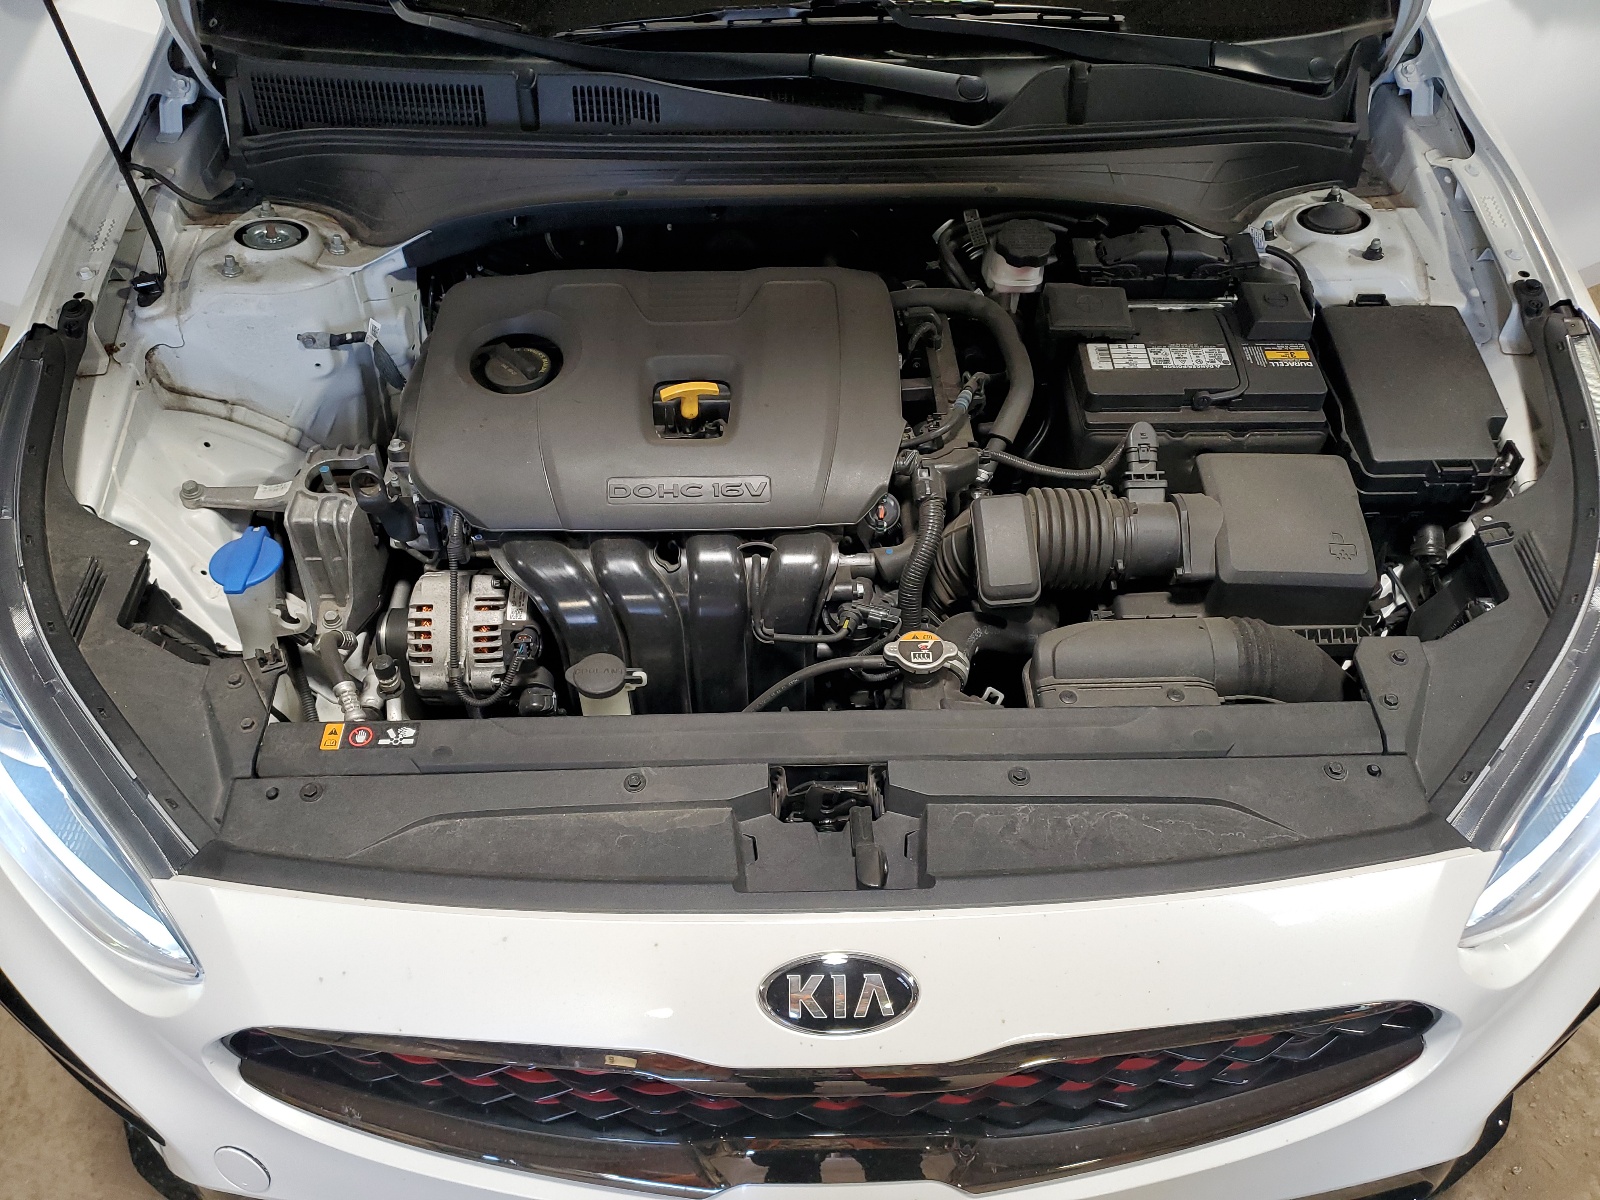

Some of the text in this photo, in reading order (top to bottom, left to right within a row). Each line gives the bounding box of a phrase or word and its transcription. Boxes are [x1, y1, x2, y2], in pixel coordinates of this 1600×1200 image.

[608, 482, 768, 498] DOHC 16V
[787, 974, 894, 1019] KIA
